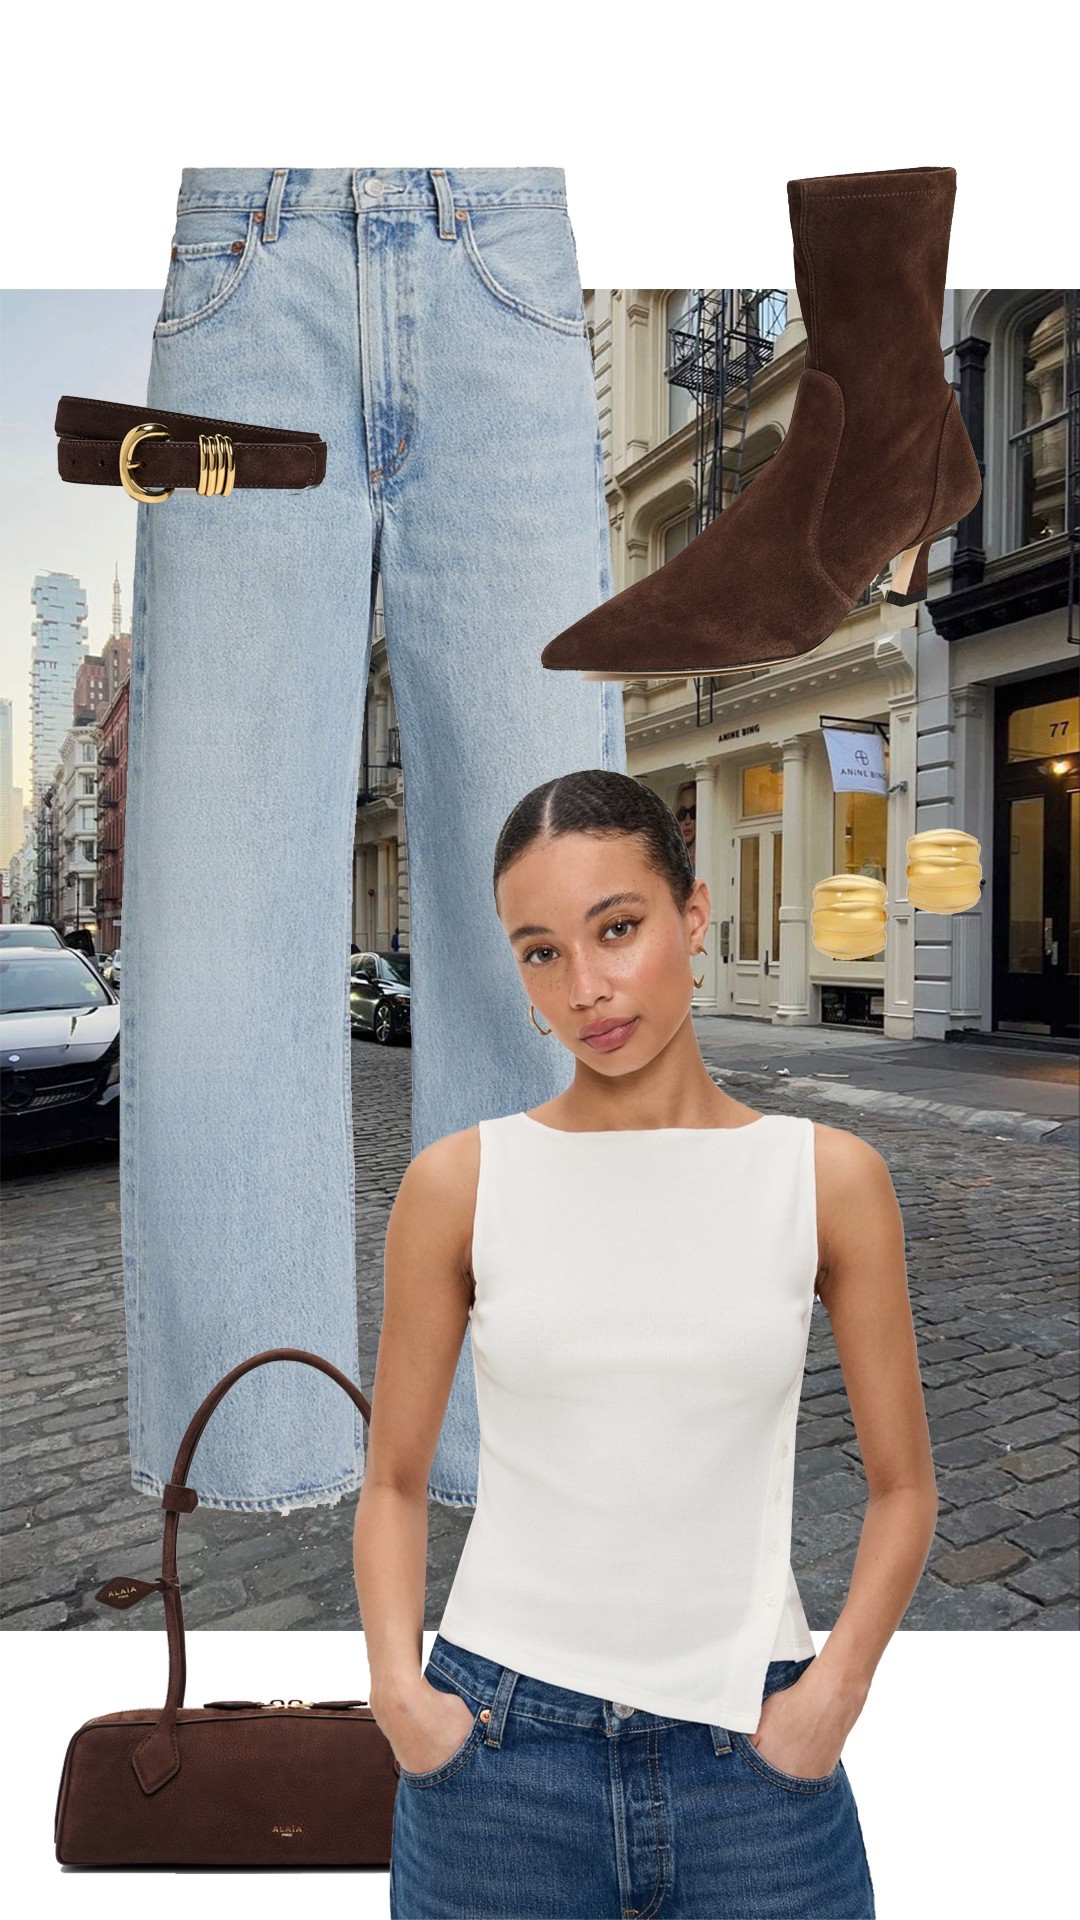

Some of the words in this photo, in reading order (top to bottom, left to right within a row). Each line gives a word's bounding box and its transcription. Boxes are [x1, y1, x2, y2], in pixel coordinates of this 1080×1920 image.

[718, 730, 740, 742] ANINE
[742, 723, 760, 736] BING
[1049, 720, 1070, 738] 77
[841, 768, 868, 777] ANINE
